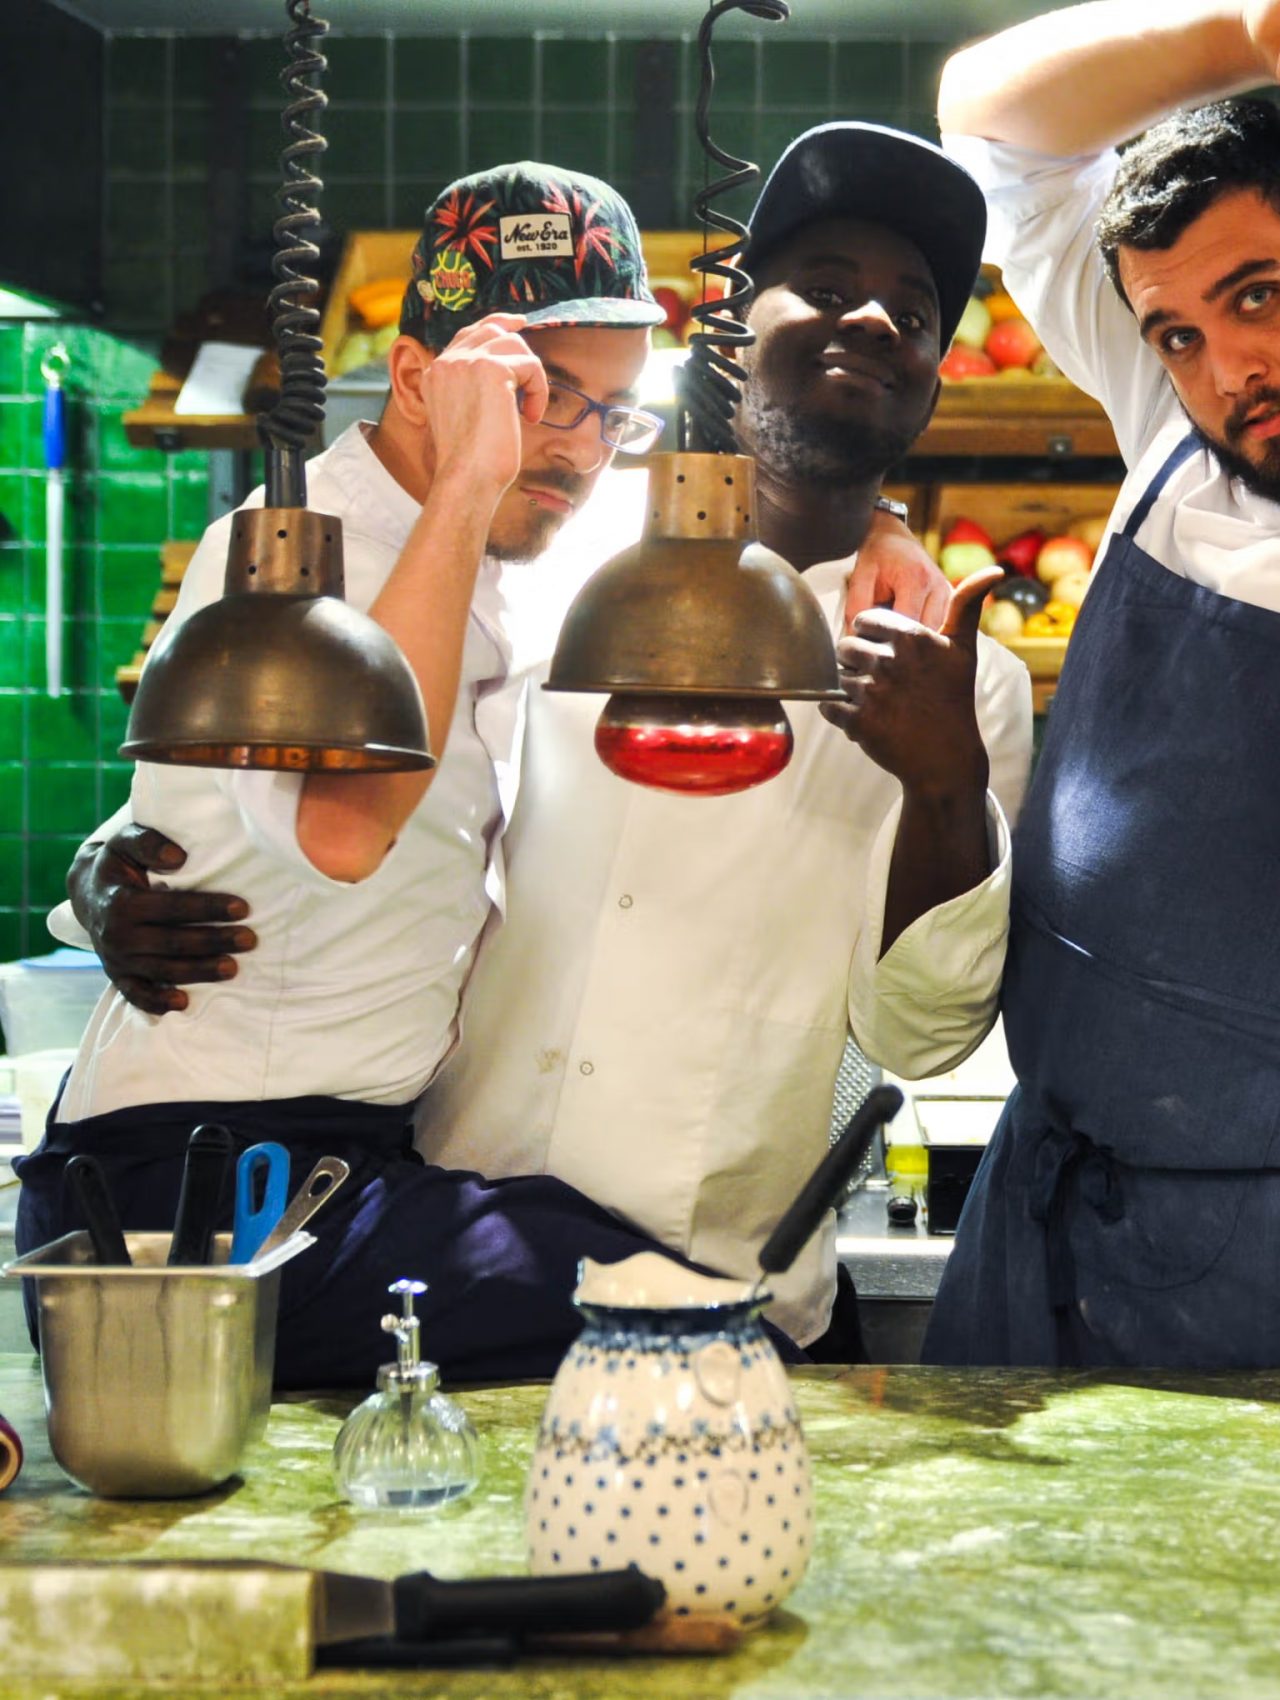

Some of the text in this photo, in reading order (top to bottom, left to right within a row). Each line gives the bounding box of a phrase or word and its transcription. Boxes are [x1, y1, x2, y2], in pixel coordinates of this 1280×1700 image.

[504, 221, 568, 243] New Era
[536, 242, 557, 251] 1920
